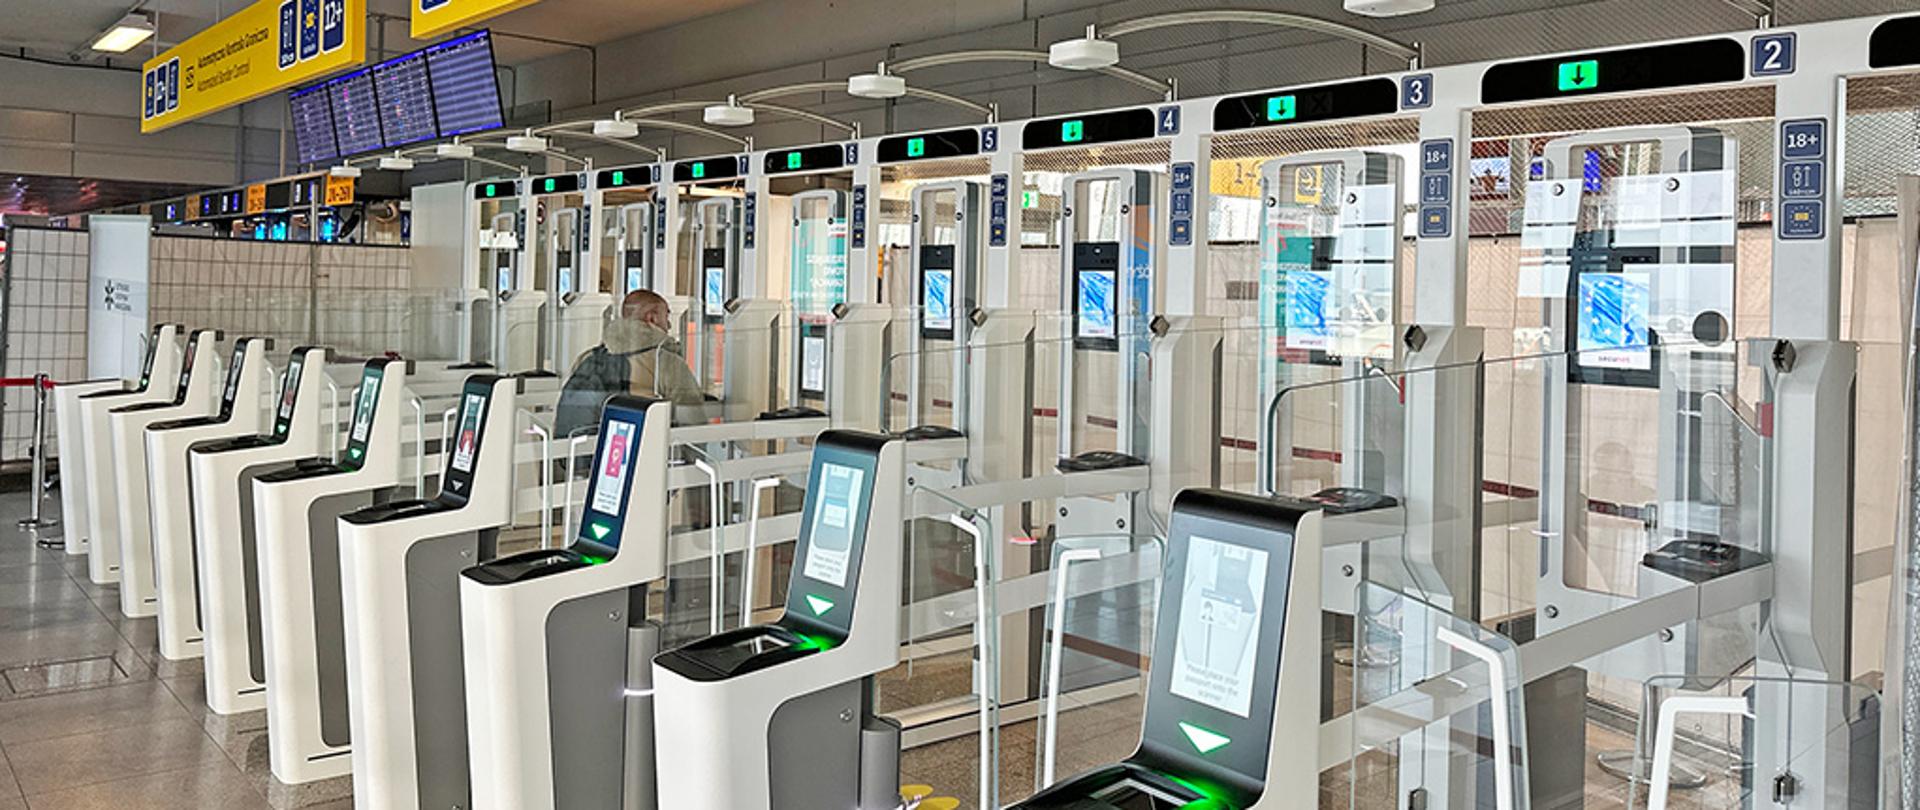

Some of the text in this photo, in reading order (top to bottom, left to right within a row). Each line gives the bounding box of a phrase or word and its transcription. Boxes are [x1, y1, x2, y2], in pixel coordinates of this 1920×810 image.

[324, 1, 343, 31] 12+
[1763, 40, 1783, 70] 2
[1410, 80, 1423, 104] 3
[1163, 110, 1174, 131] 4
[985, 131, 994, 149] 5
[1787, 133, 1818, 149] 18+
[848, 146, 856, 162] 6
[1426, 150, 1447, 163] 18+
